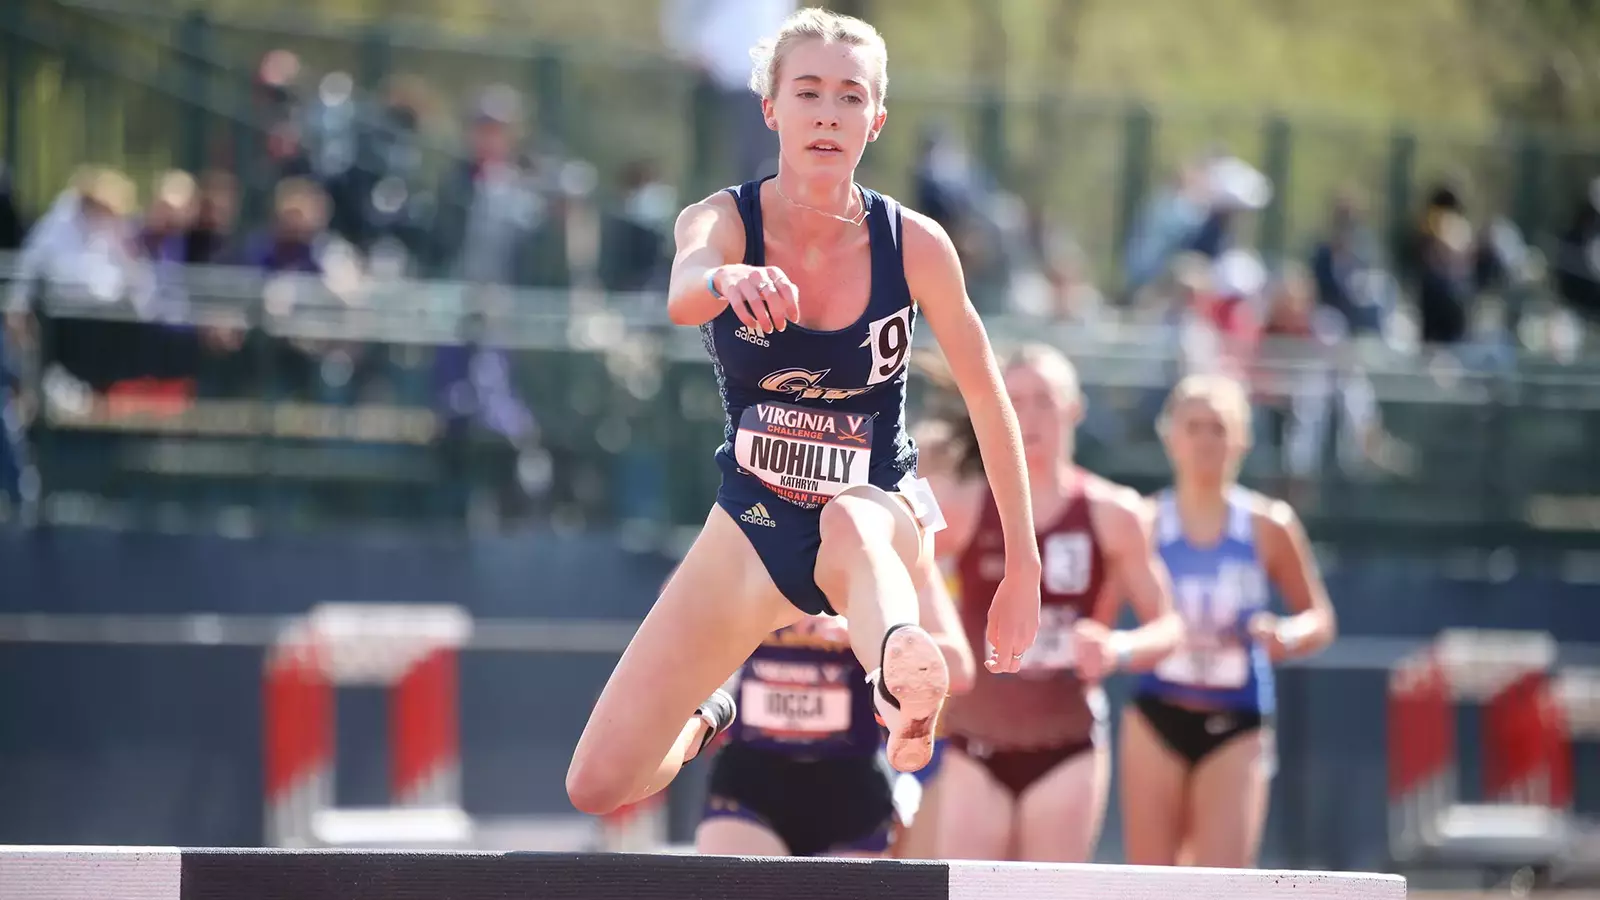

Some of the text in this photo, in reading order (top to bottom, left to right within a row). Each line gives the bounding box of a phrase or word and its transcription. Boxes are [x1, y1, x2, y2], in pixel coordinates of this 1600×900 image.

[734, 329, 770, 348] adidas
[878, 316, 909, 377] 9
[756, 403, 836, 434] VIRGINIA
[766, 424, 824, 441] CHALLENGE
[749, 435, 857, 484] NOHILLY
[780, 475, 819, 492] KATHRYN
[740, 513, 776, 528] adidas
